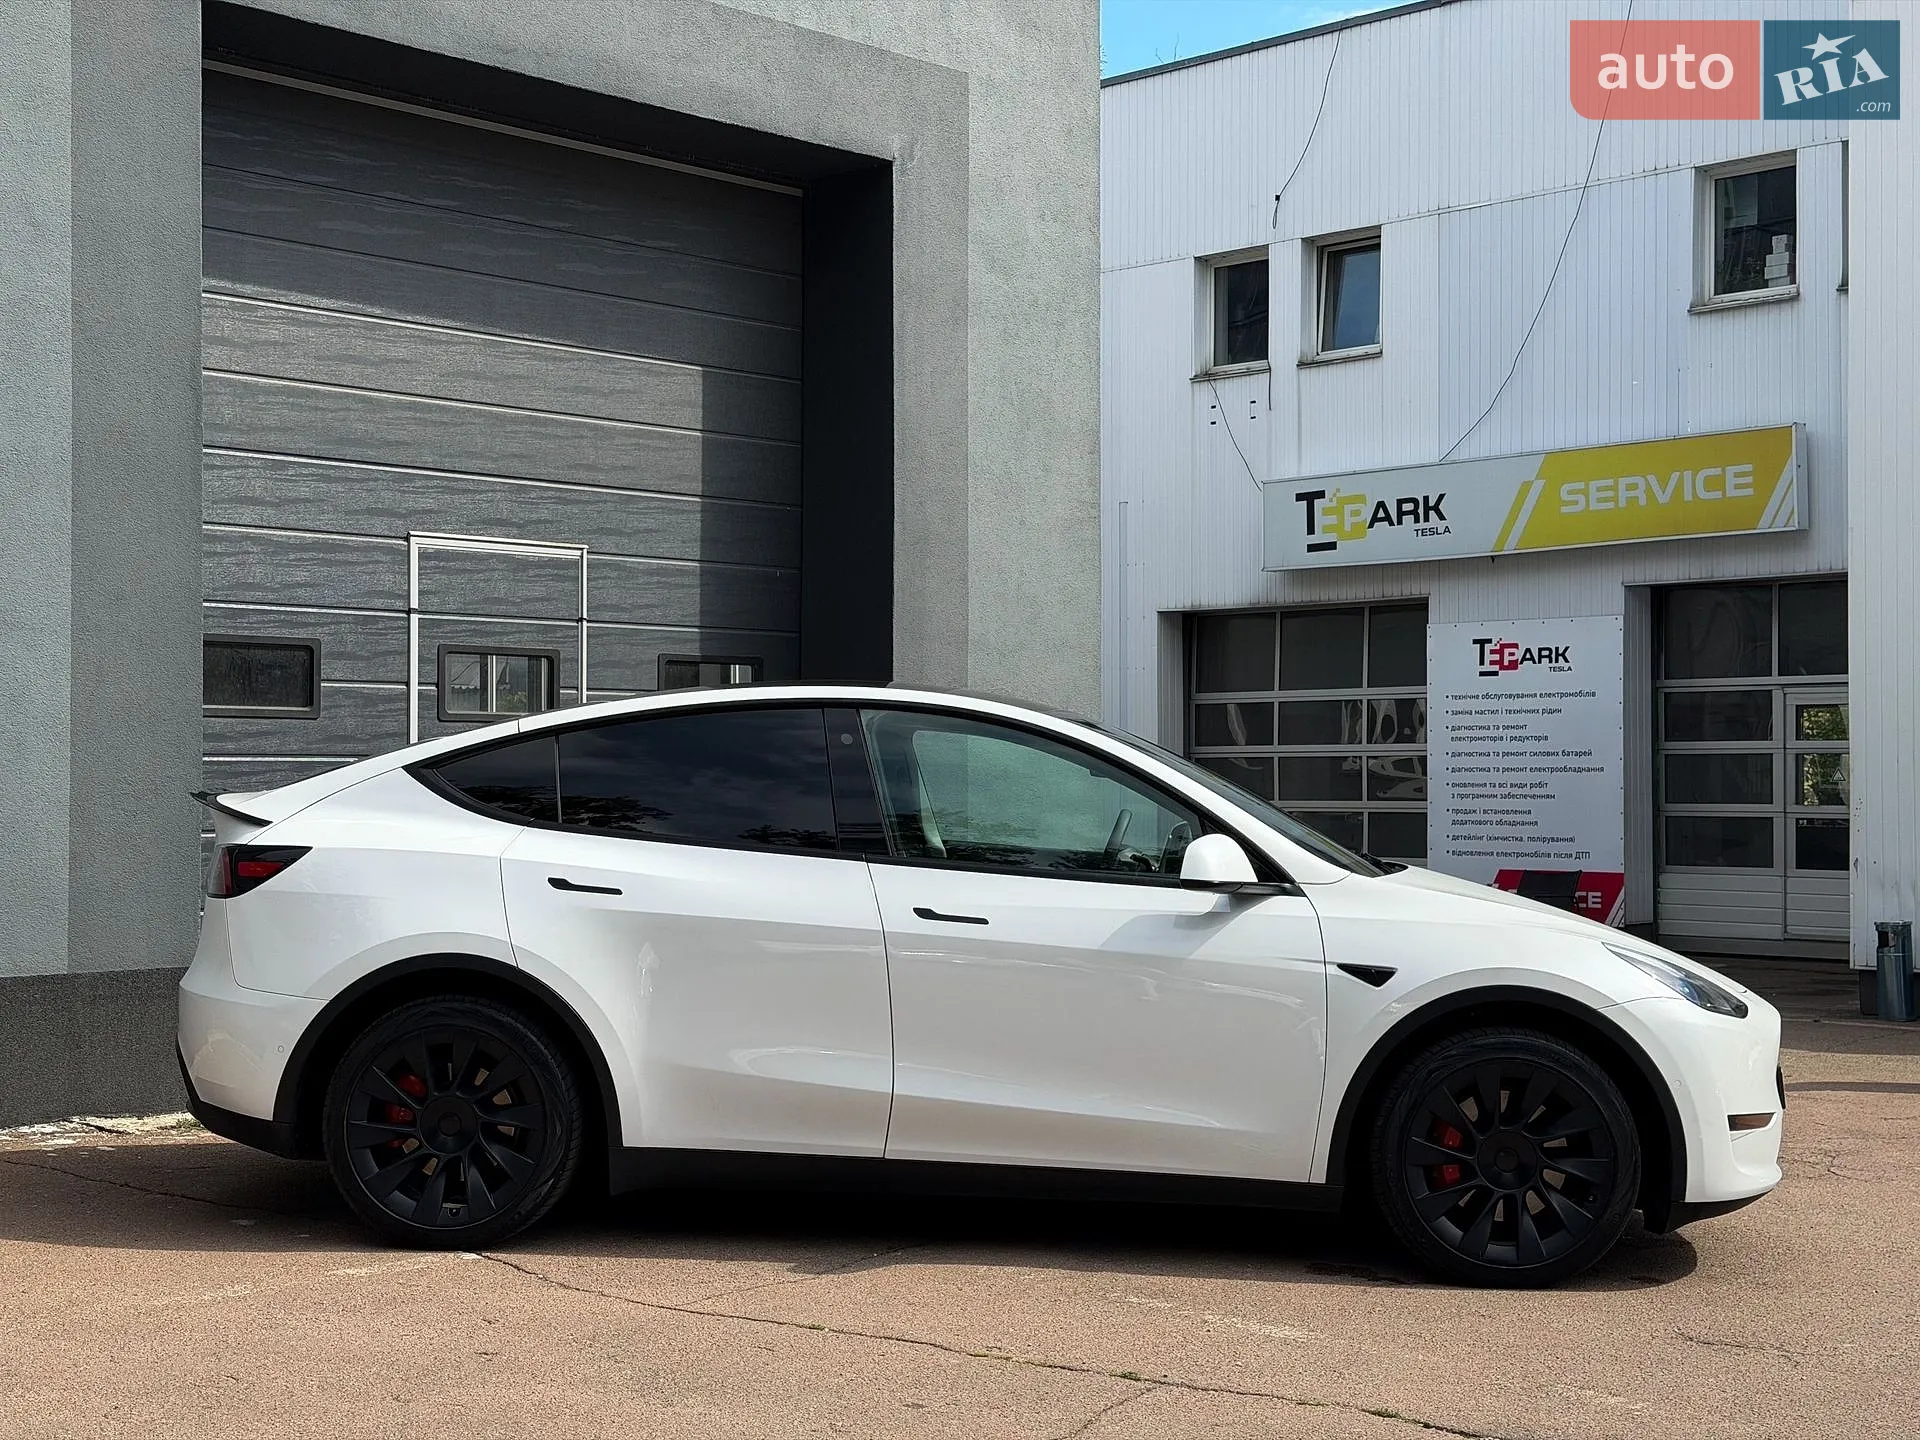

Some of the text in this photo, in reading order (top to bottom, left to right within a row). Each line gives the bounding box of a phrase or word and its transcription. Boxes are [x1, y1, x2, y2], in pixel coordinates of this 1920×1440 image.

[1559, 463, 1754, 514] SERVICE
[1413, 525, 1451, 538] TESLA
[1451, 690, 1597, 702] технічне обслуговування електромобілів
[1451, 708, 1473, 716] заміна
[1474, 708, 1500, 716] мастил
[1505, 707, 1540, 716] технічних
[1541, 707, 1562, 716] рідин
[1451, 724, 1491, 732] діагностика
[1502, 724, 1528, 732] ремонт
[1451, 735, 1504, 743] електромоторів
[1510, 734, 1549, 743] редукторів
[1451, 751, 1491, 759] діагностика
[1502, 751, 1528, 759] ремонт
[1561, 749, 1593, 759] батарей
[1451, 766, 1491, 774] діагностика
[1502, 766, 1528, 774] ремонт
[1529, 765, 1605, 774] електрообладнання
[1498, 781, 1508, 789] всі
[1529, 781, 1549, 790] робіт
[1451, 808, 1477, 816] продаж
[1482, 808, 1532, 816] встановлення
[1451, 819, 1539, 827] додаткового обладнання
[1451, 834, 1485, 842] детейлінг
[1527, 835, 1576, 845] полірування)
[1451, 849, 1591, 860] відновлення електромобілів після ДТП
